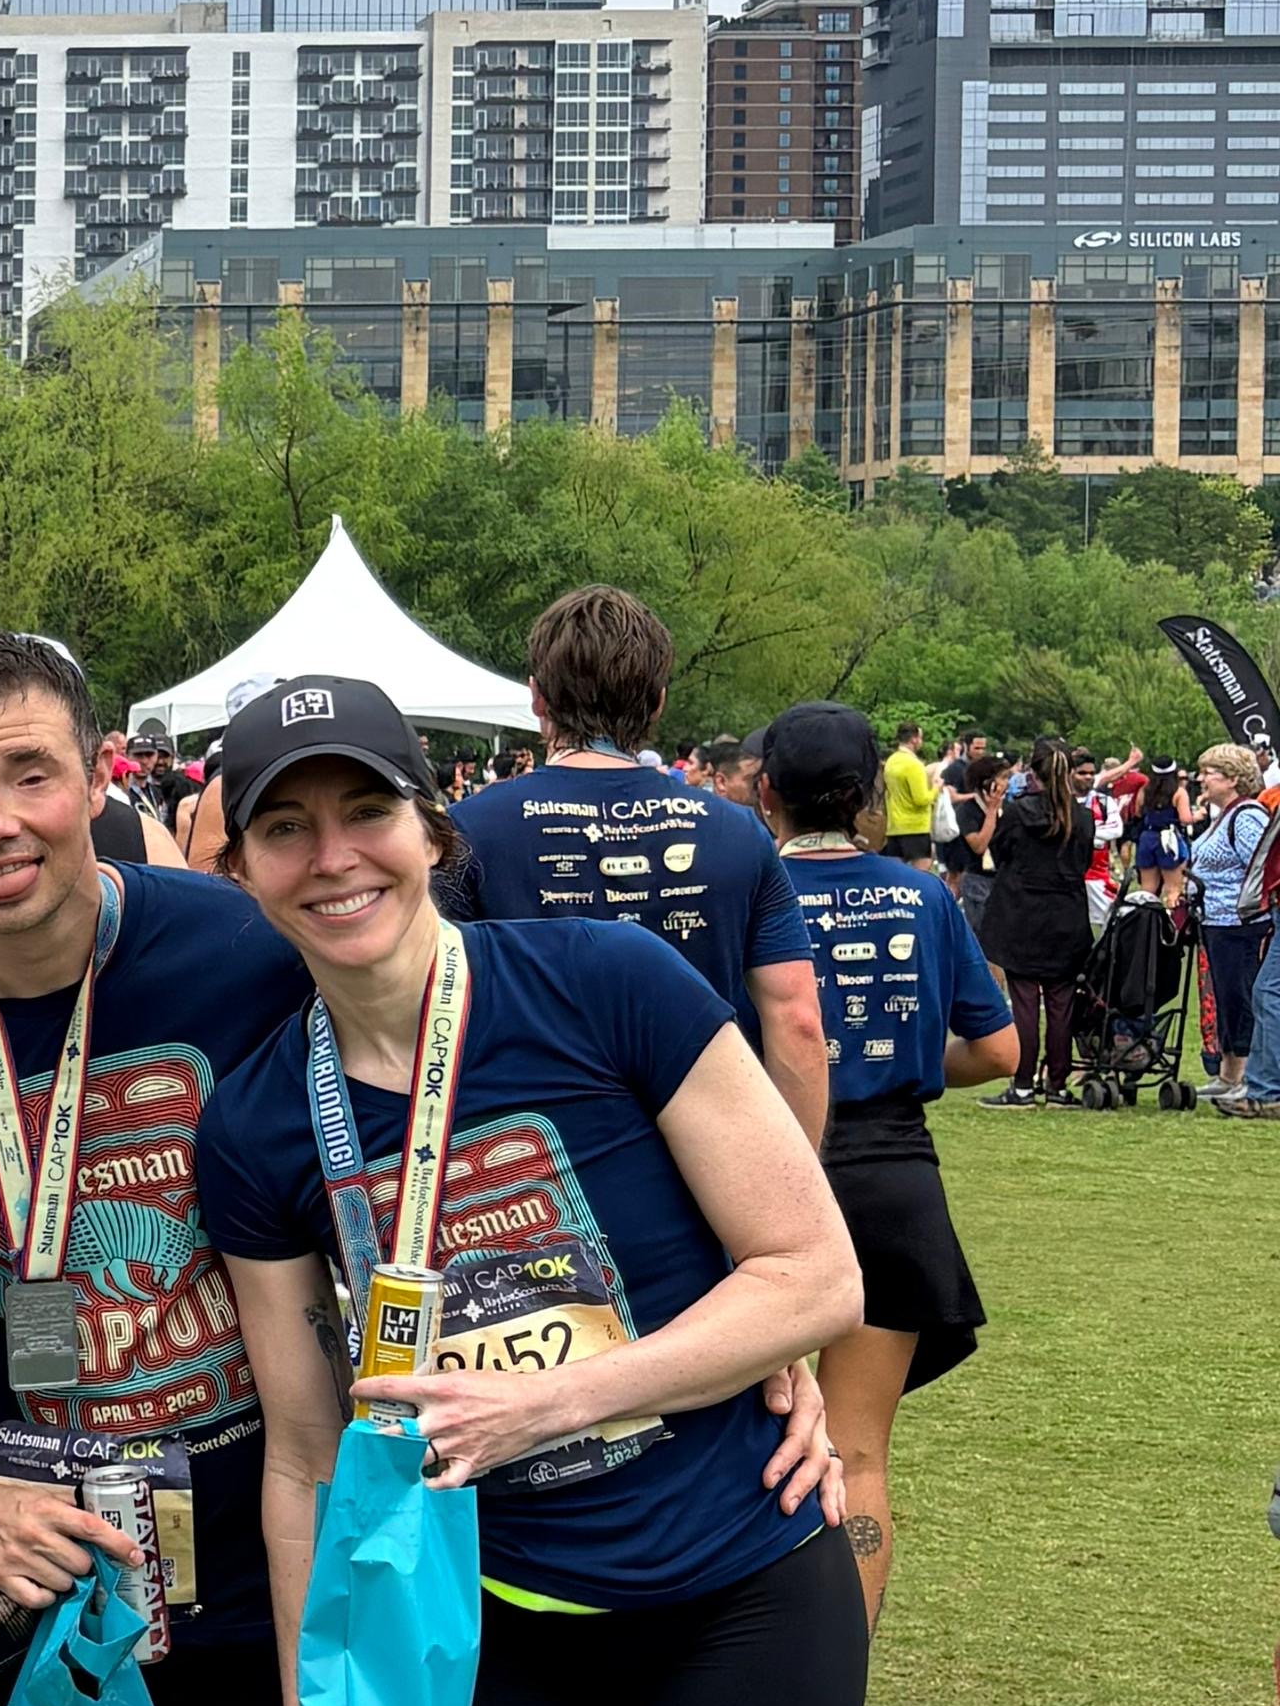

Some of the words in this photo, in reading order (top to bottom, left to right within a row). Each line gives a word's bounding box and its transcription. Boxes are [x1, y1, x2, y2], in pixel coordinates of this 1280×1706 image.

[1129, 232, 1194, 247] SILICON
[1201, 232, 1242, 247] LABS
[1185, 626, 1247, 705] Statesman
[523, 801, 599, 818] Statesman
[611, 798, 708, 820] CAP10K
[845, 886, 923, 906] CAP10K
[663, 917, 707, 930] ULTRA
[439, 943, 460, 1006] Statesman
[425, 1015, 453, 1100] CAP10K
[316, 1057, 356, 1173] RUNNING!
[47, 1103, 74, 1182] CAP10K
[76, 1146, 191, 1195] esman
[37, 1192, 60, 1256] Statesman
[437, 1197, 549, 1253] tesman
[474, 1253, 577, 1291] CAP10K
[383, 1325, 416, 1344] NT
[386, 1307, 416, 1327] LM
[91, 1401, 137, 1425] APRIL
[138, 1401, 154, 1421] 12
[166, 1387, 207, 1413] 2026
[72, 1437, 165, 1461] CAP10K
[603, 1445, 643, 1469] 2026
[133, 1479, 157, 1555] STAY
[144, 1559, 170, 1660] SALTY
